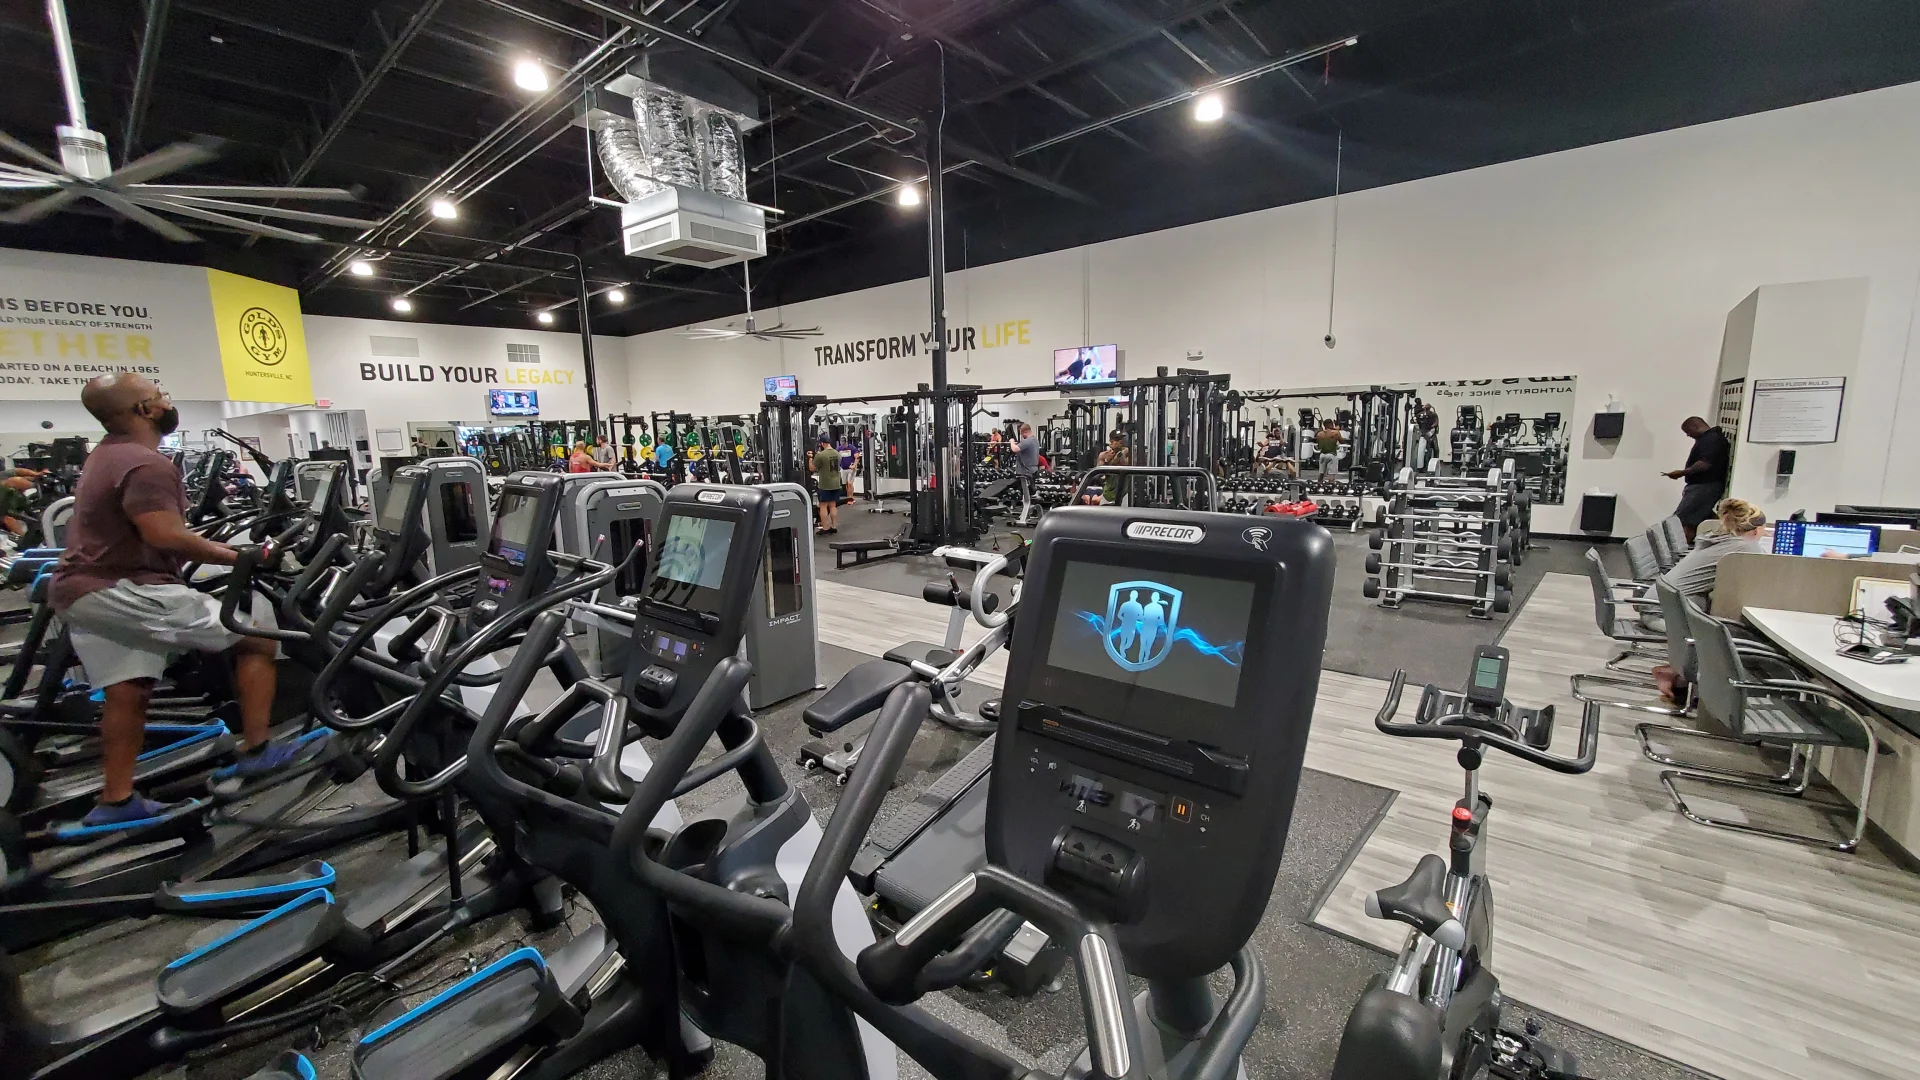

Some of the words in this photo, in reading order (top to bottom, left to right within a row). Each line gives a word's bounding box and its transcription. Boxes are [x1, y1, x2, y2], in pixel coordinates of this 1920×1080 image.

[24, 299, 106, 316] BEFORE
[110, 304, 152, 319] YOU.
[17, 317, 46, 325] YOUR
[48, 318, 87, 327] LEGACY
[89, 320, 102, 328] OF
[104, 321, 152, 330] STRENGTH
[244, 312, 282, 340] GOLD'S
[815, 334, 916, 367] TRANSFORM
[920, 327, 976, 354] YUR
[981, 319, 1031, 348] LIFE
[251, 346, 282, 361] GYM
[43, 363, 61, 372] ON
[64, 364, 71, 372] A
[74, 364, 114, 373] BEACH
[117, 365, 128, 373] IN
[131, 366, 160, 374] 1965
[360, 363, 434, 382] BUILD
[439, 366, 498, 383] YOUR
[504, 368, 574, 384] LEGACY
[39, 376, 71, 385] TAKE
[1141, 525, 1194, 540] PRECOR
[768, 613, 801, 627] IMPACT
